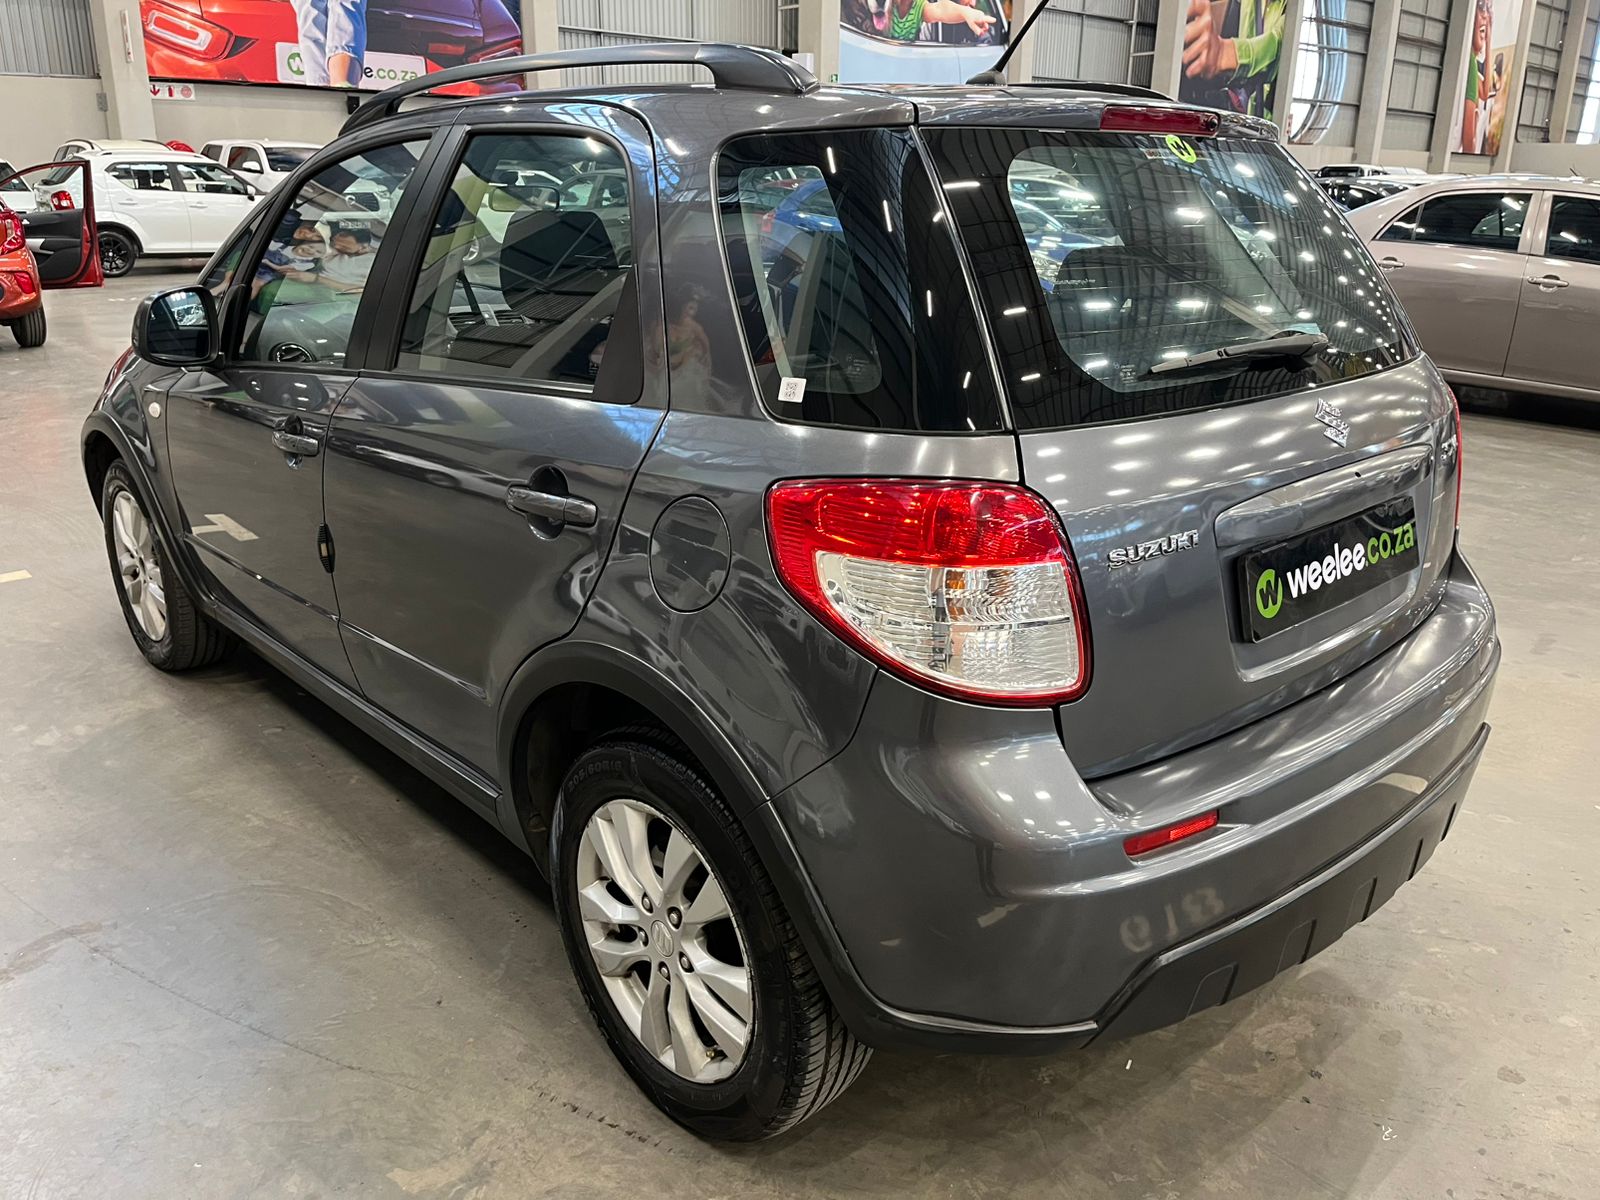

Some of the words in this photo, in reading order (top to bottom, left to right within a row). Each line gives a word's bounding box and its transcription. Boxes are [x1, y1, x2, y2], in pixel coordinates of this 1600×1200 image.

[363, 66, 418, 81] e.co.za
[1107, 529, 1200, 569] SUZUKI
[1286, 522, 1415, 599] weelee.co.za
